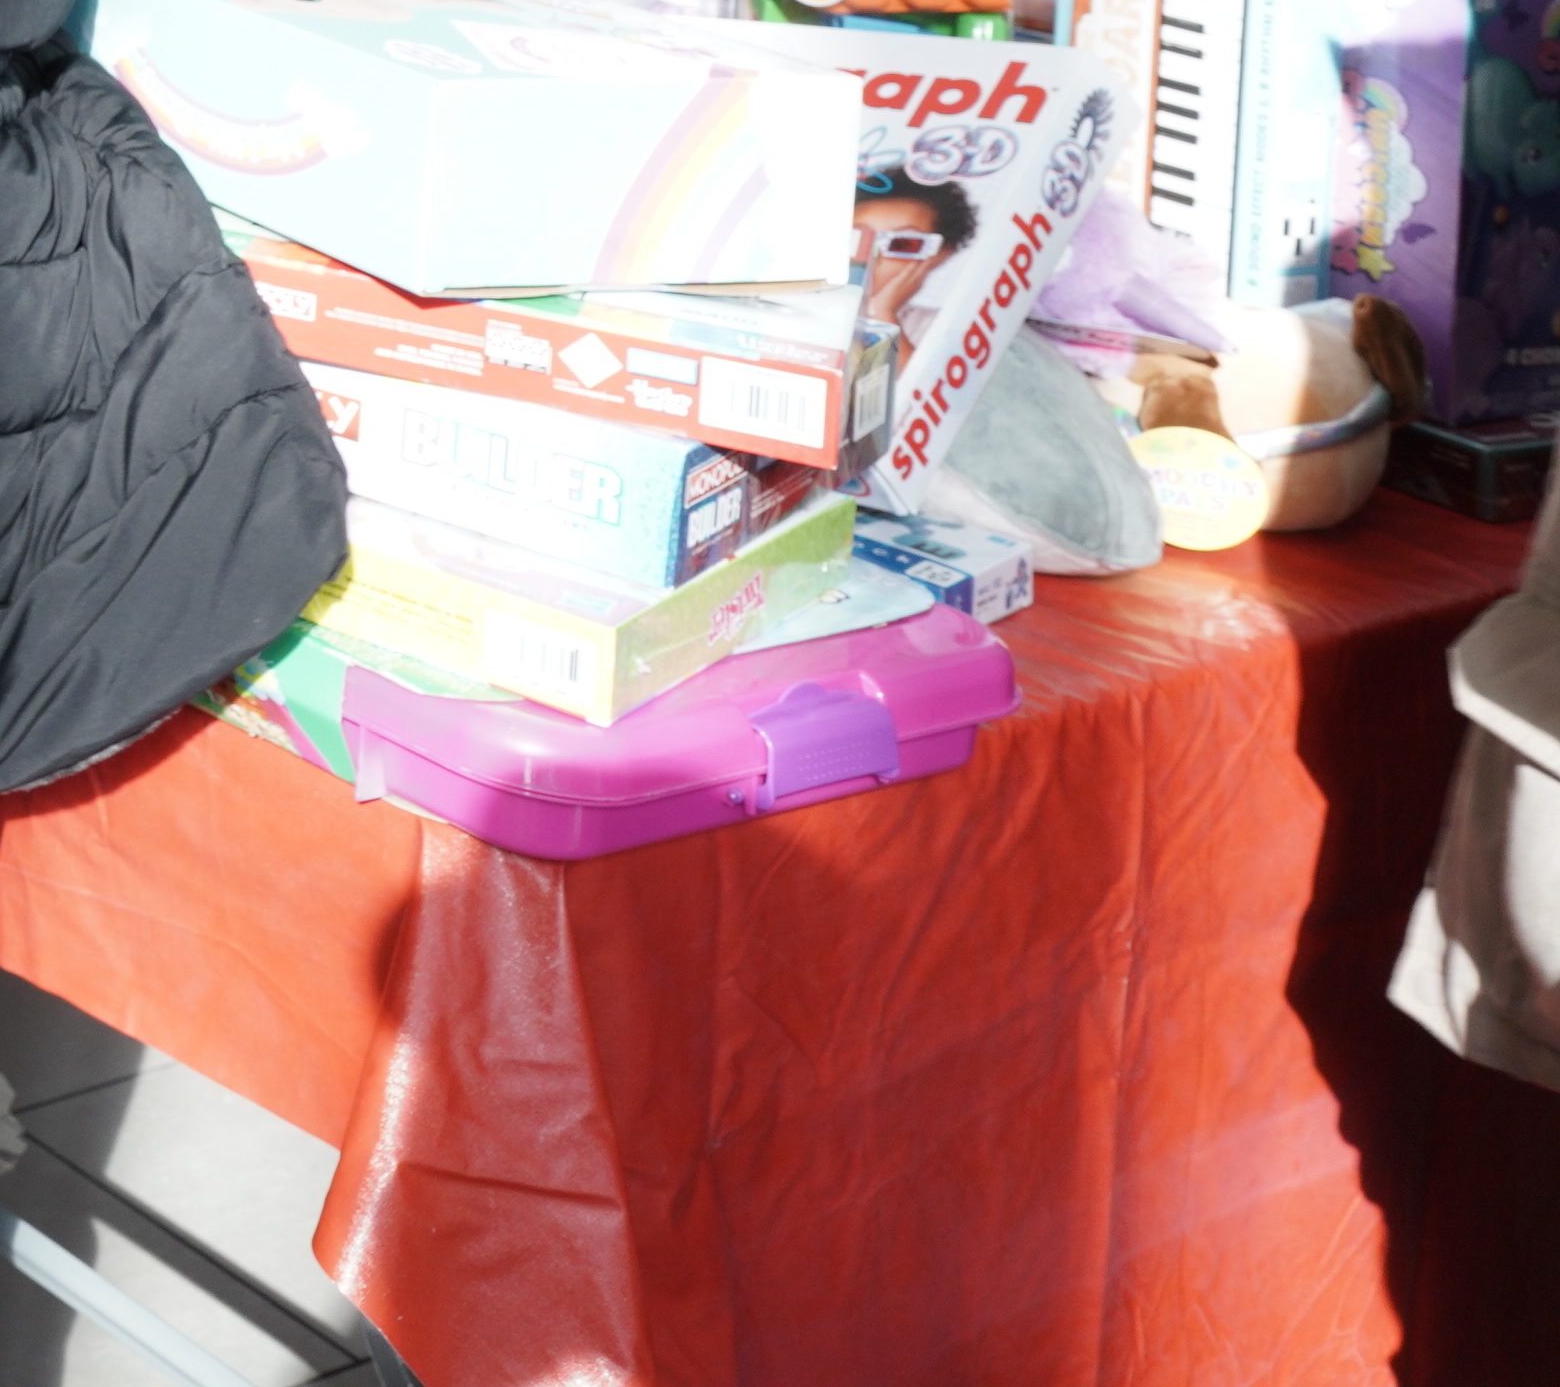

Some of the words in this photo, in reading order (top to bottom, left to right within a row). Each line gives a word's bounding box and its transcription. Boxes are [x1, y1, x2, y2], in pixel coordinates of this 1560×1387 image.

[889, 213, 1053, 482] spirograph
[402, 408, 622, 527] BUILDER
[687, 487, 743, 548] BUILDER
